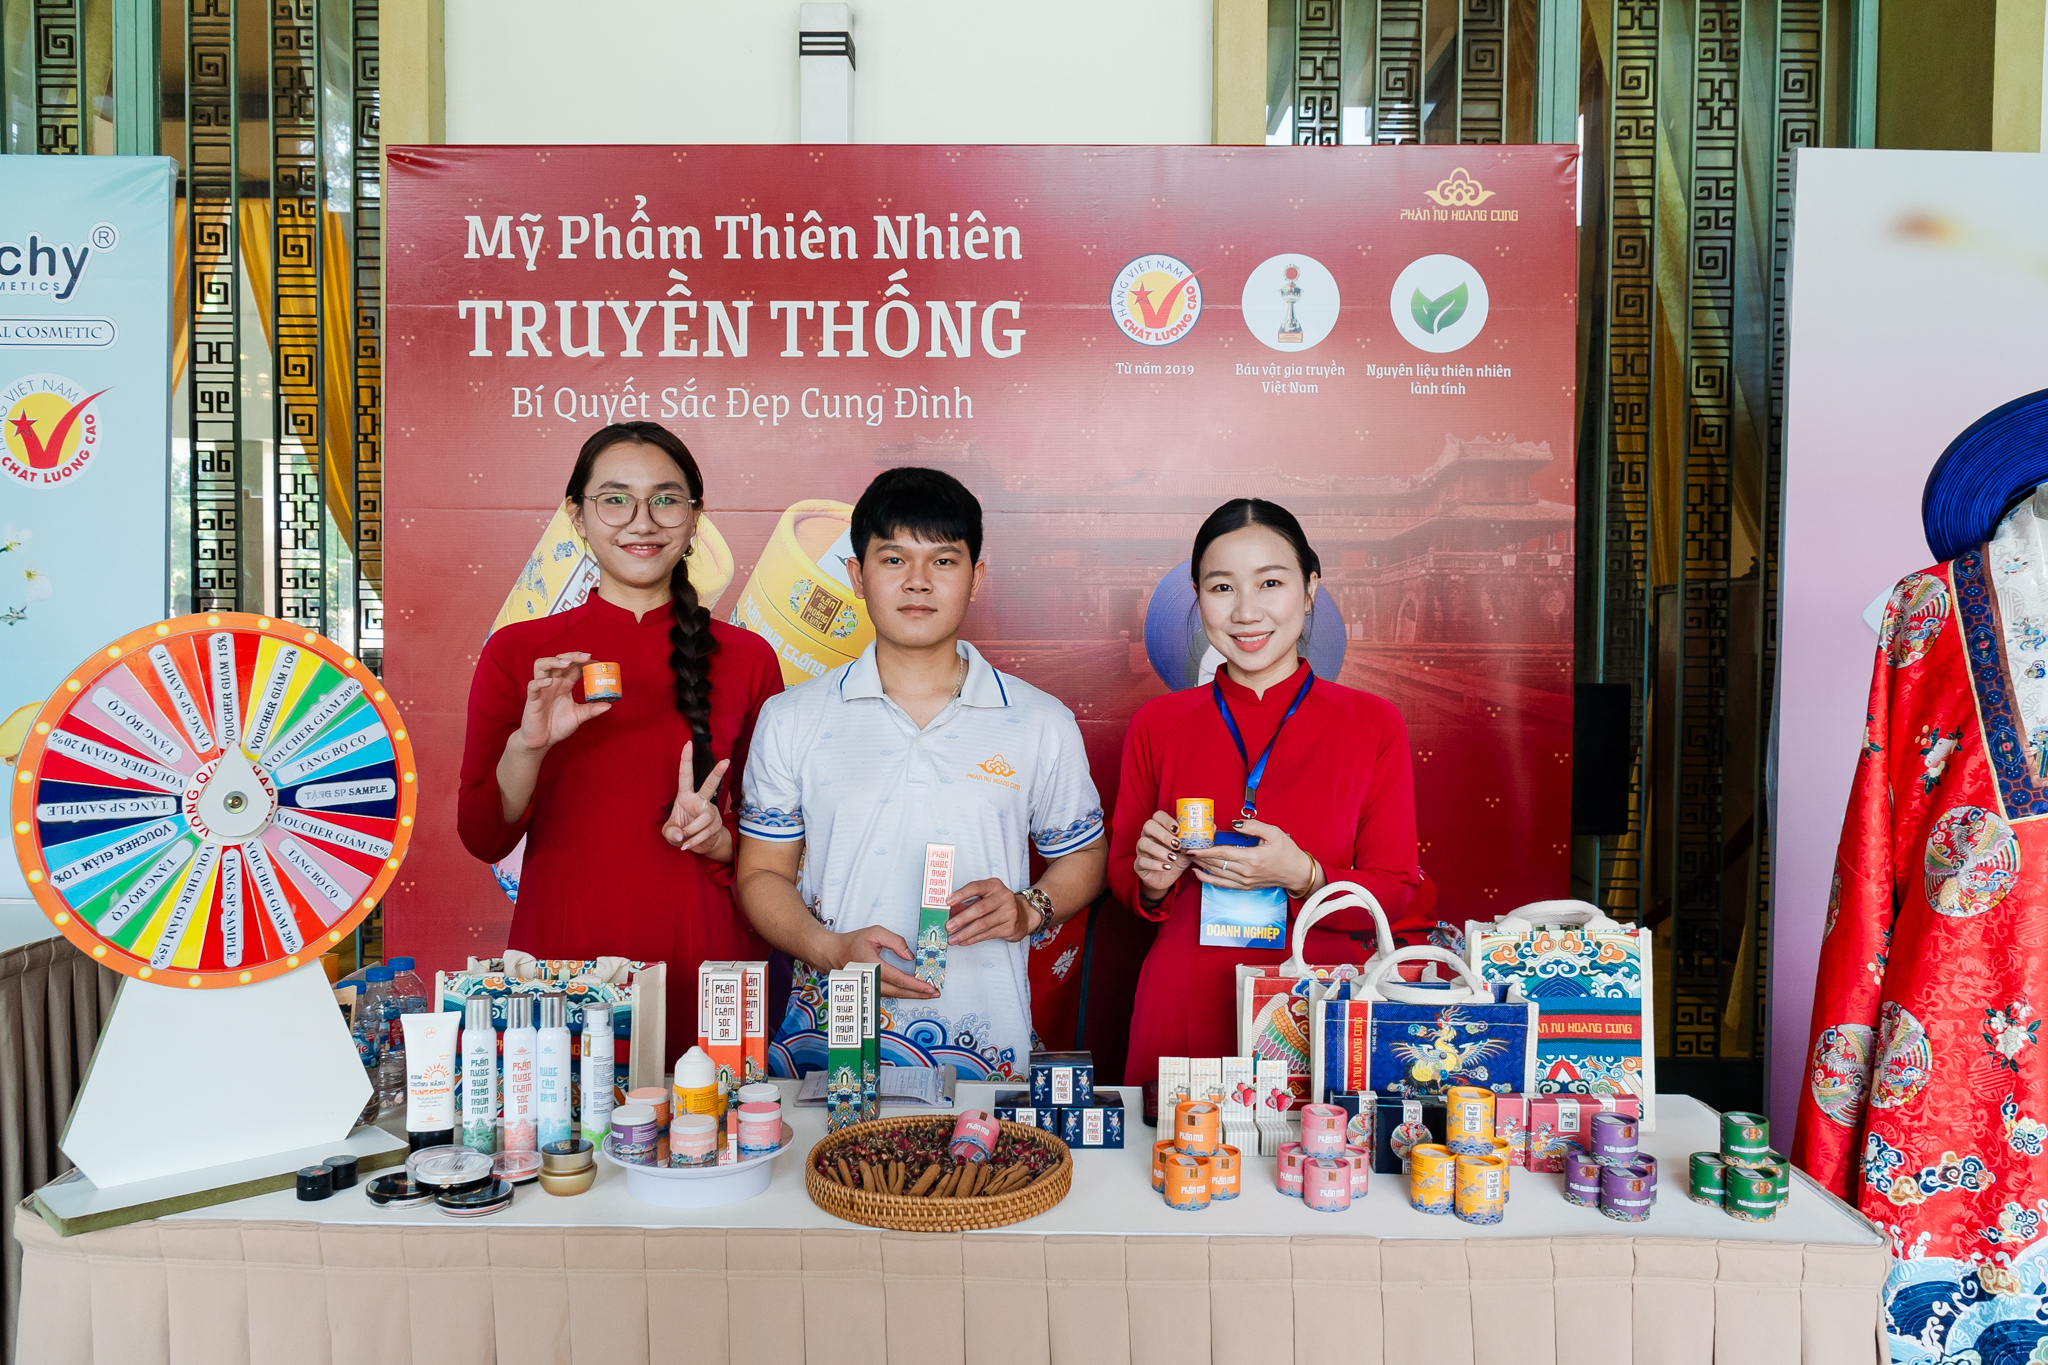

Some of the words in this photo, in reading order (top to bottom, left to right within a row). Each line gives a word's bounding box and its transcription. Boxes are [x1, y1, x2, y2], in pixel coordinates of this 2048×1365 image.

[1491, 210, 1518, 221] CUNG
[464, 212, 544, 271] Mỹ
[558, 195, 702, 260] Phẩm
[716, 210, 858, 260] Thiên
[874, 210, 1022, 260] Nhiên
[1115, 280, 1128, 317] HÀNG
[1127, 260, 1150, 278] VIỆT
[1156, 260, 1183, 278] NAM
[458, 268, 753, 358] TRUYỀN
[770, 268, 1026, 359] THỐNG
[1124, 319, 1151, 340] CHẤT
[1186, 286, 1196, 310] CAO
[15, 327, 102, 339] COSMETIC
[1116, 362, 1132, 374] Từ
[1135, 362, 1161, 374] năm
[1165, 365, 1194, 375] 2019
[1236, 362, 1259, 375] Báu
[1262, 362, 1281, 378] vật
[1284, 363, 1302, 378] gia
[1306, 360, 1345, 378] truyền
[1366, 363, 1413, 379] Nguyên
[1416, 363, 1438, 379] liệu
[1442, 364, 1473, 377] thiên
[1476, 364, 1511, 377] nhiên
[43, 379, 79, 402] NAM
[1261, 381, 1286, 395] Việt
[1290, 382, 1318, 393] Nam
[1411, 382, 1438, 394] lành
[1441, 382, 1466, 394] tính
[512, 385, 544, 419] Bí
[554, 376, 650, 426] Quyết
[661, 378, 716, 419] Sắc
[726, 388, 790, 426] Đẹp
[801, 388, 883, 426] Cung
[894, 385, 973, 419] Đình
[85, 414, 96, 444] CAO
[218, 636, 228, 657] 15%
[156, 651, 186, 699] SAMPLE
[181, 701, 194, 715] SP
[251, 700, 277, 750] VOUCHER
[269, 672, 288, 700] GIẢM
[283, 650, 296, 670] 10%
[264, 724, 314, 768] VOUCHER
[340, 682, 360, 702] 20%
[52, 732, 79, 749] 20%
[297, 751, 331, 772] TẶNG
[121, 760, 183, 788] VOUCHER
[334, 789, 346, 797] SP
[348, 785, 387, 796] SAMPLE
[47, 803, 106, 816] SAMPLE
[110, 803, 126, 813] SP
[130, 799, 168, 812] TẶNG
[116, 824, 171, 854] VOUCHER
[277, 814, 333, 839] VOUCHER
[336, 833, 366, 850] GIẢM
[369, 843, 389, 857] 15%
[287, 848, 313, 872] TẶNG
[54, 867, 80, 883] 10%
[145, 859, 177, 888] TẶNG
[181, 846, 214, 904] VOUCHER
[223, 856, 237, 890] TẶNG
[226, 891, 236, 907] SP
[247, 841, 274, 898] VOUCHER
[269, 898, 289, 930] GIẢM
[283, 929, 298, 952] 20%
[166, 907, 186, 940] GIẢM
[226, 909, 236, 959] SAMPLE
[1207, 924, 1240, 937] DOANH
[1243, 924, 1280, 942] NGHIỆP
[153, 943, 170, 965] 15%
[1354, 1017, 1363, 1036] CUNG
[1605, 1024, 1632, 1034] CUNG
